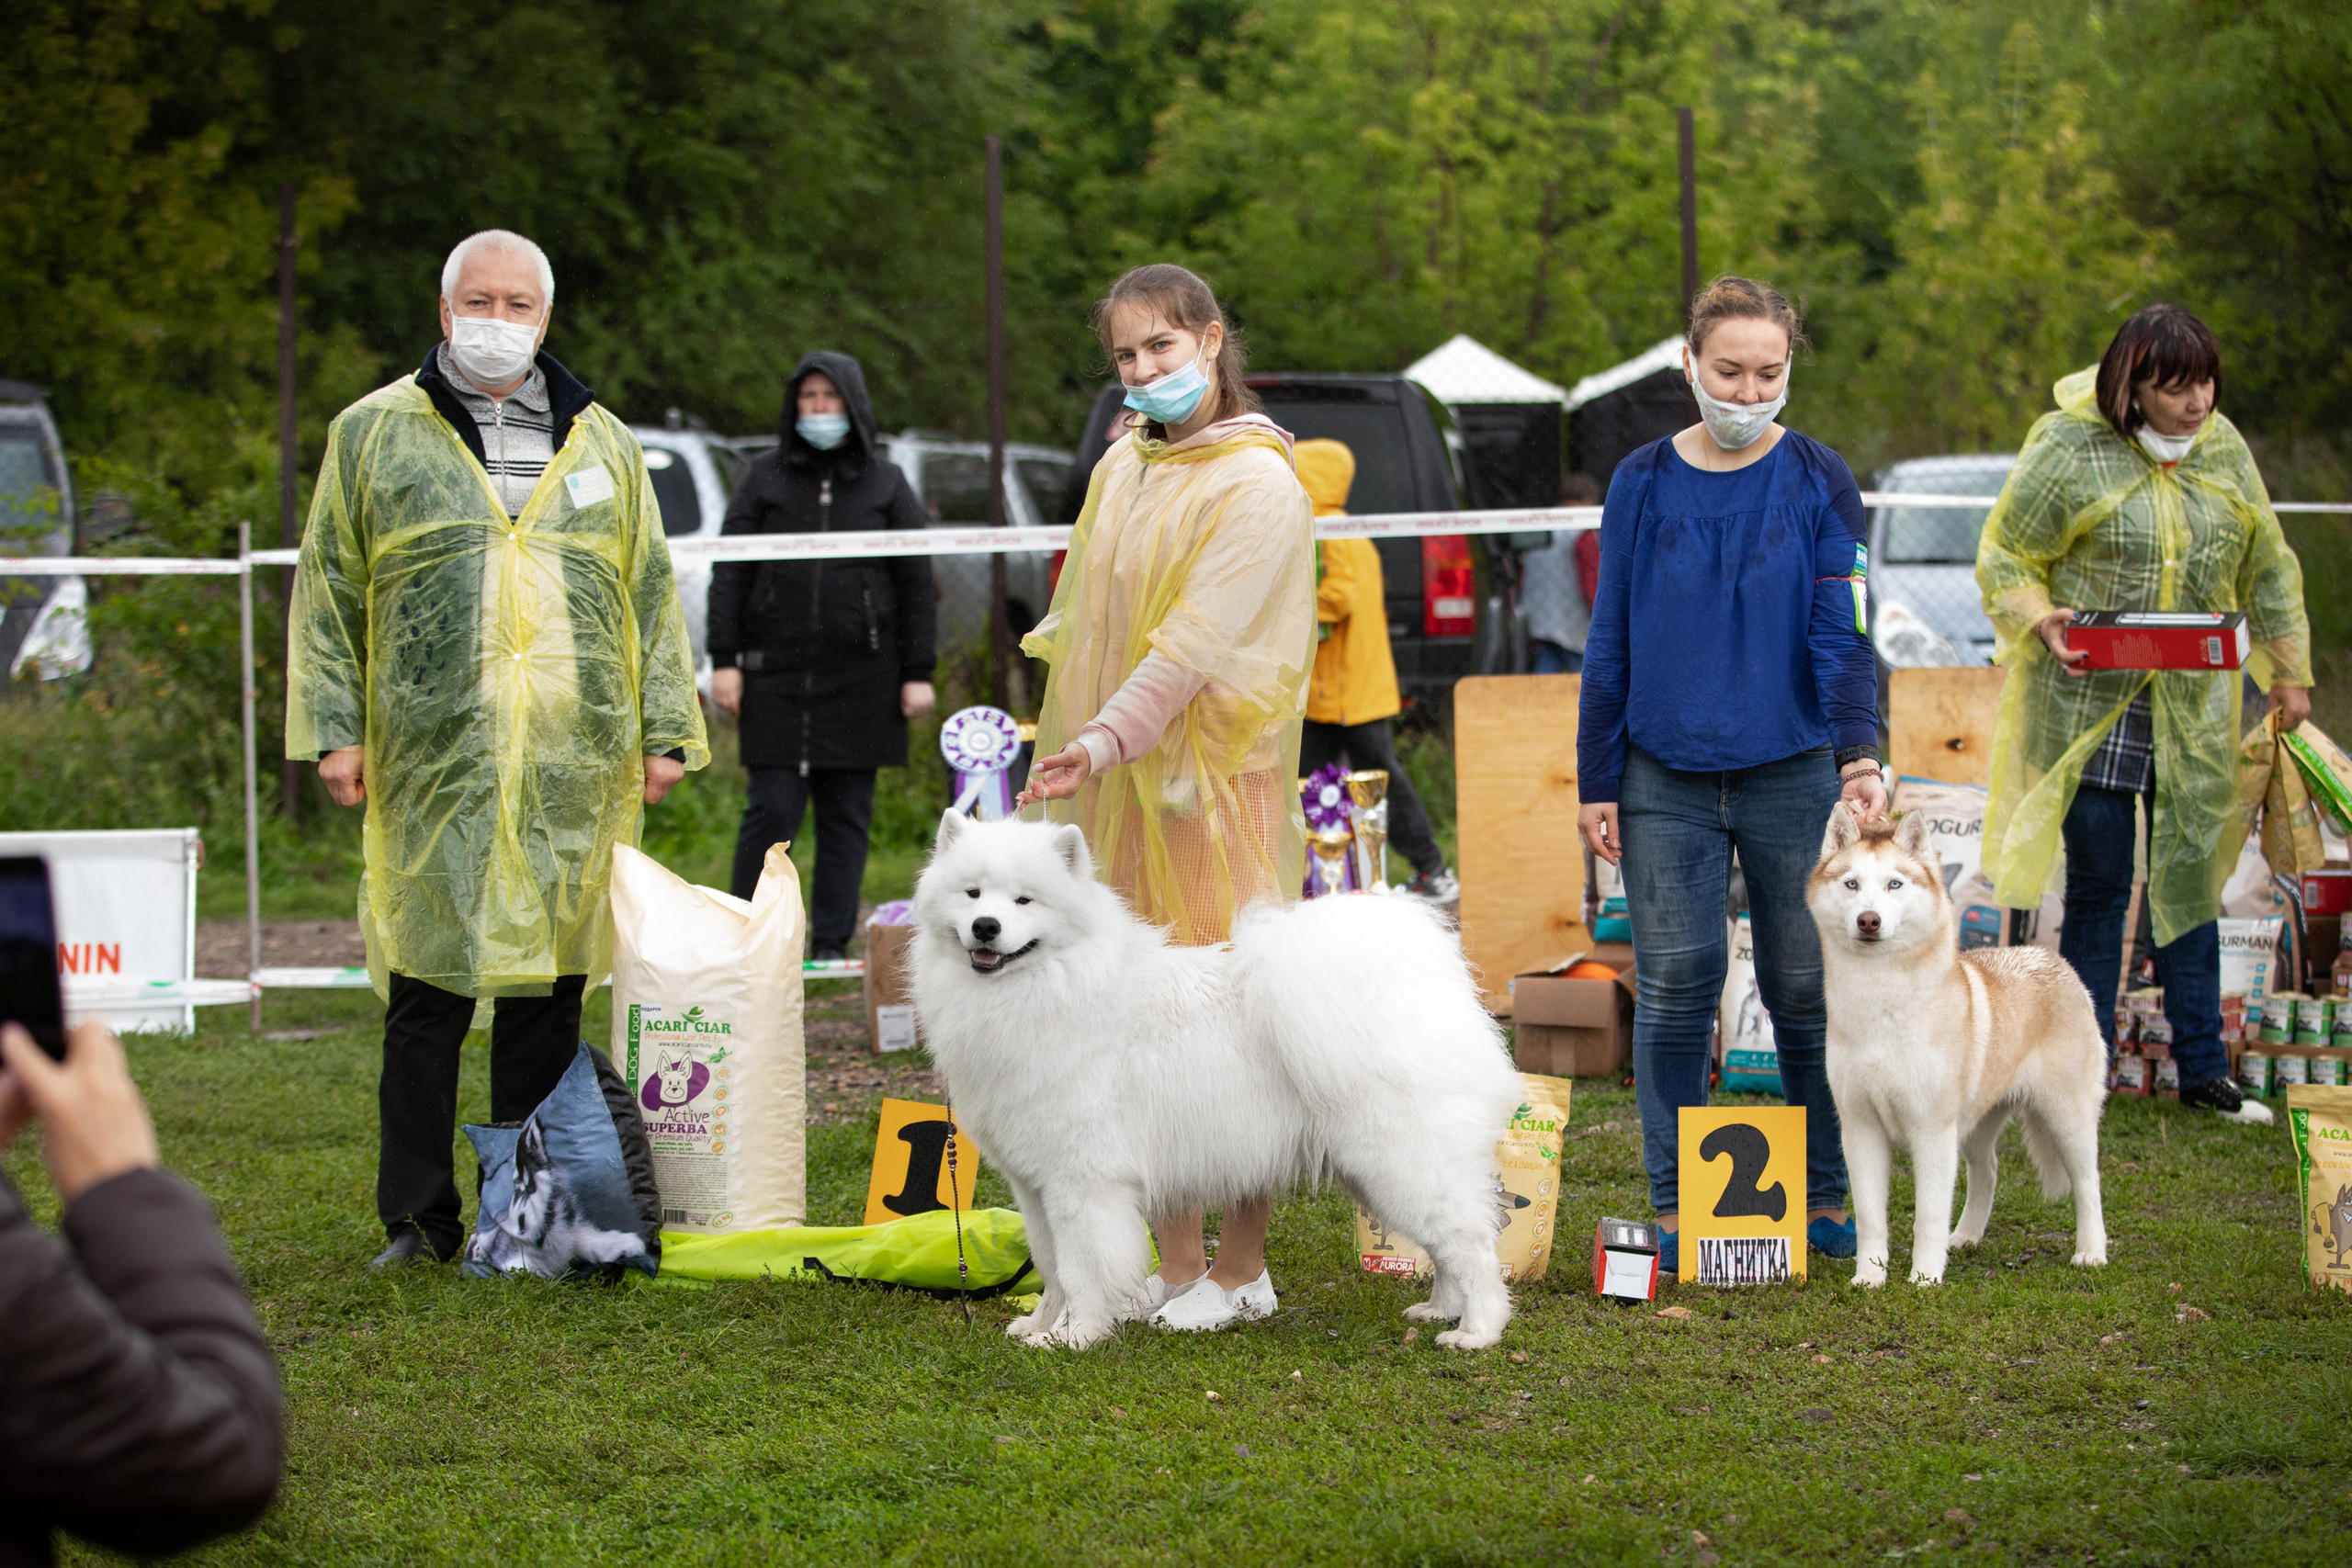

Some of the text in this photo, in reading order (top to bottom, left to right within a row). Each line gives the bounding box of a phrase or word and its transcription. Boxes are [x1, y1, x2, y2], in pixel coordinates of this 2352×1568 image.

[2219, 935, 2272, 949] URMAN
[629, 1007, 640, 1042] Food
[644, 1021, 731, 1034] ACARI CIAR
[644, 1032, 681, 1041] Professional
[628, 1047, 639, 1080] DOG
[664, 1108, 710, 1123] Active
[644, 1122, 707, 1134] SUPERBA
[1521, 1119, 1555, 1133] CIAR
[655, 1133, 684, 1141] Premium
[685, 1134, 712, 1144] Quality
[2317, 1127, 2352, 1141] ACA
[882, 1120, 958, 1217] 1
[1519, 1161, 1544, 1172] champion
[1699, 1123, 1787, 1223] 2
[1379, 1260, 1414, 1272] AURORA
[1700, 1238, 1788, 1283] МАГНИТКА
